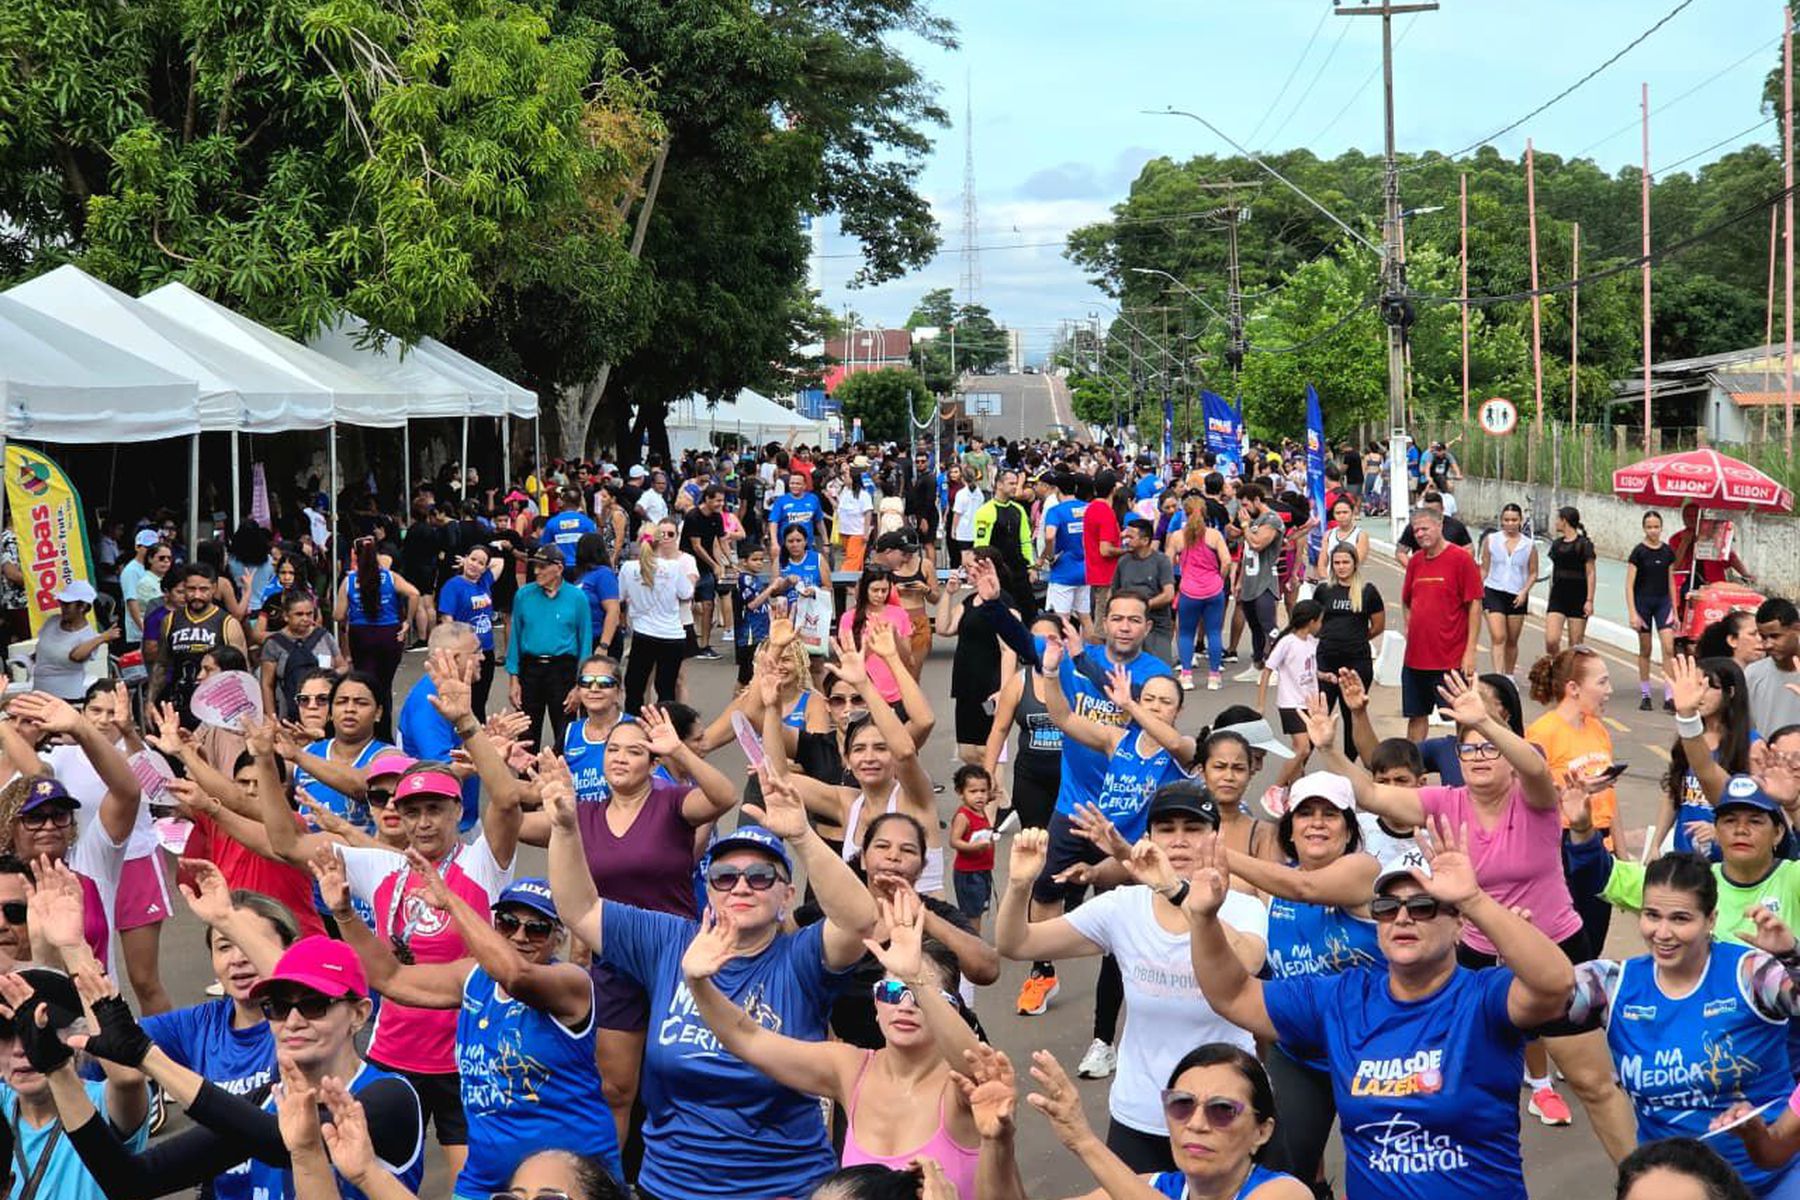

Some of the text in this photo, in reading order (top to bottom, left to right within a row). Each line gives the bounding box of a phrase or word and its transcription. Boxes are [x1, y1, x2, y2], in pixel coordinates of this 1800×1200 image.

[1620, 476, 1645, 487] KIBON
[1666, 479, 1706, 492] KIBON
[1732, 484, 1769, 498] KIBON
[31, 504, 62, 613] Polpas
[61, 559, 73, 585] olpa
[172, 627, 216, 645] TEAM
[583, 768, 597, 778] NA
[1098, 791, 1139, 811] CERTA
[1291, 943, 1312, 958] NA
[1655, 1048, 1683, 1067] NA
[1357, 1058, 1415, 1079] RUAS
[1621, 1054, 1704, 1090] MEDIDA
[1351, 1073, 1419, 1096] LAZER
